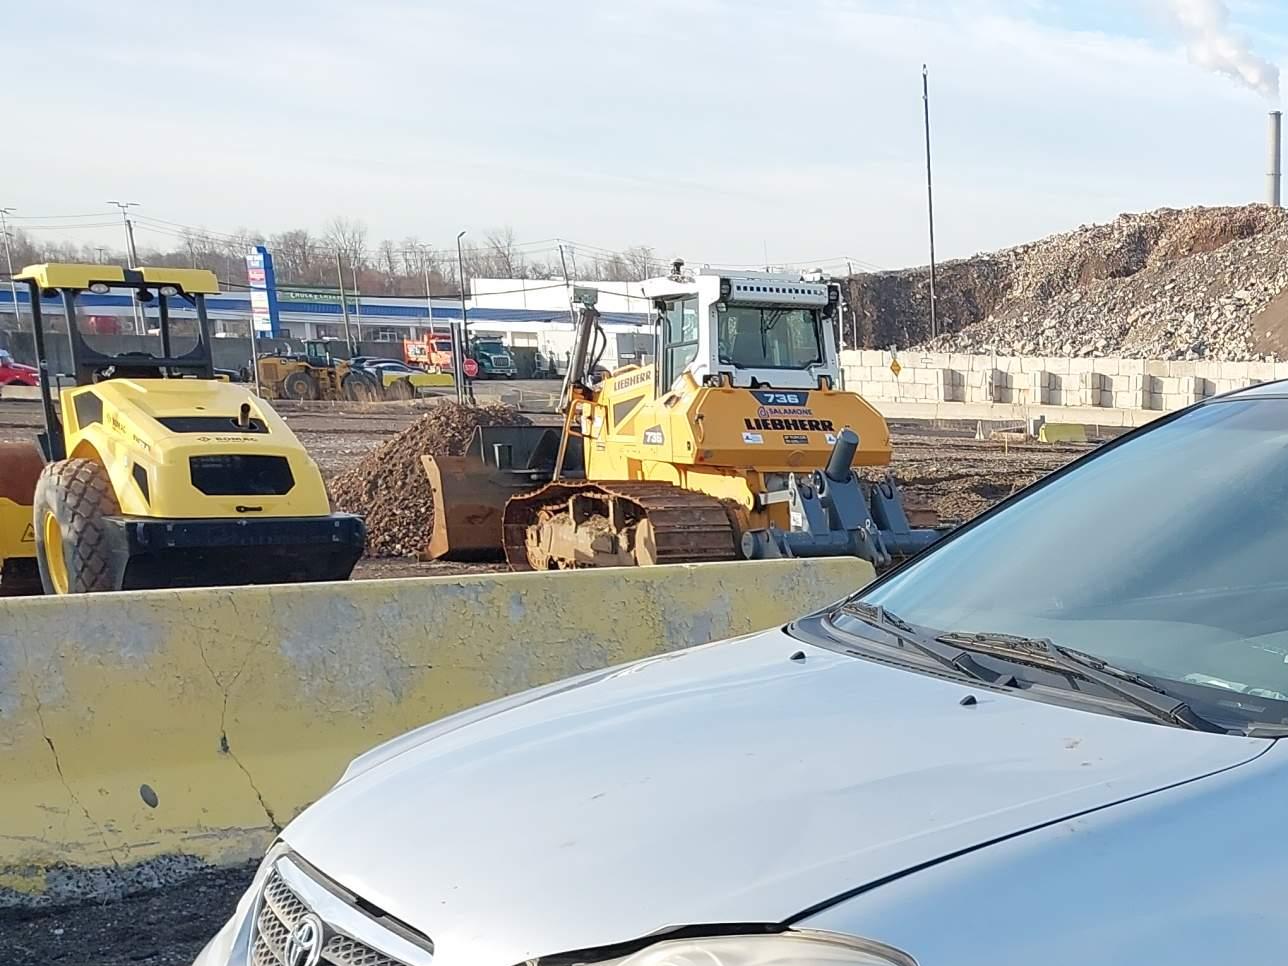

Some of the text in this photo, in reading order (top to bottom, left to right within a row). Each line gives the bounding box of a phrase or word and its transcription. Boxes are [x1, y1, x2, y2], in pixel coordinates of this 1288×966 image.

[614, 371, 652, 391] LIEBHERR
[763, 393, 799, 404] 736
[744, 418, 835, 431] LIEBHERR
